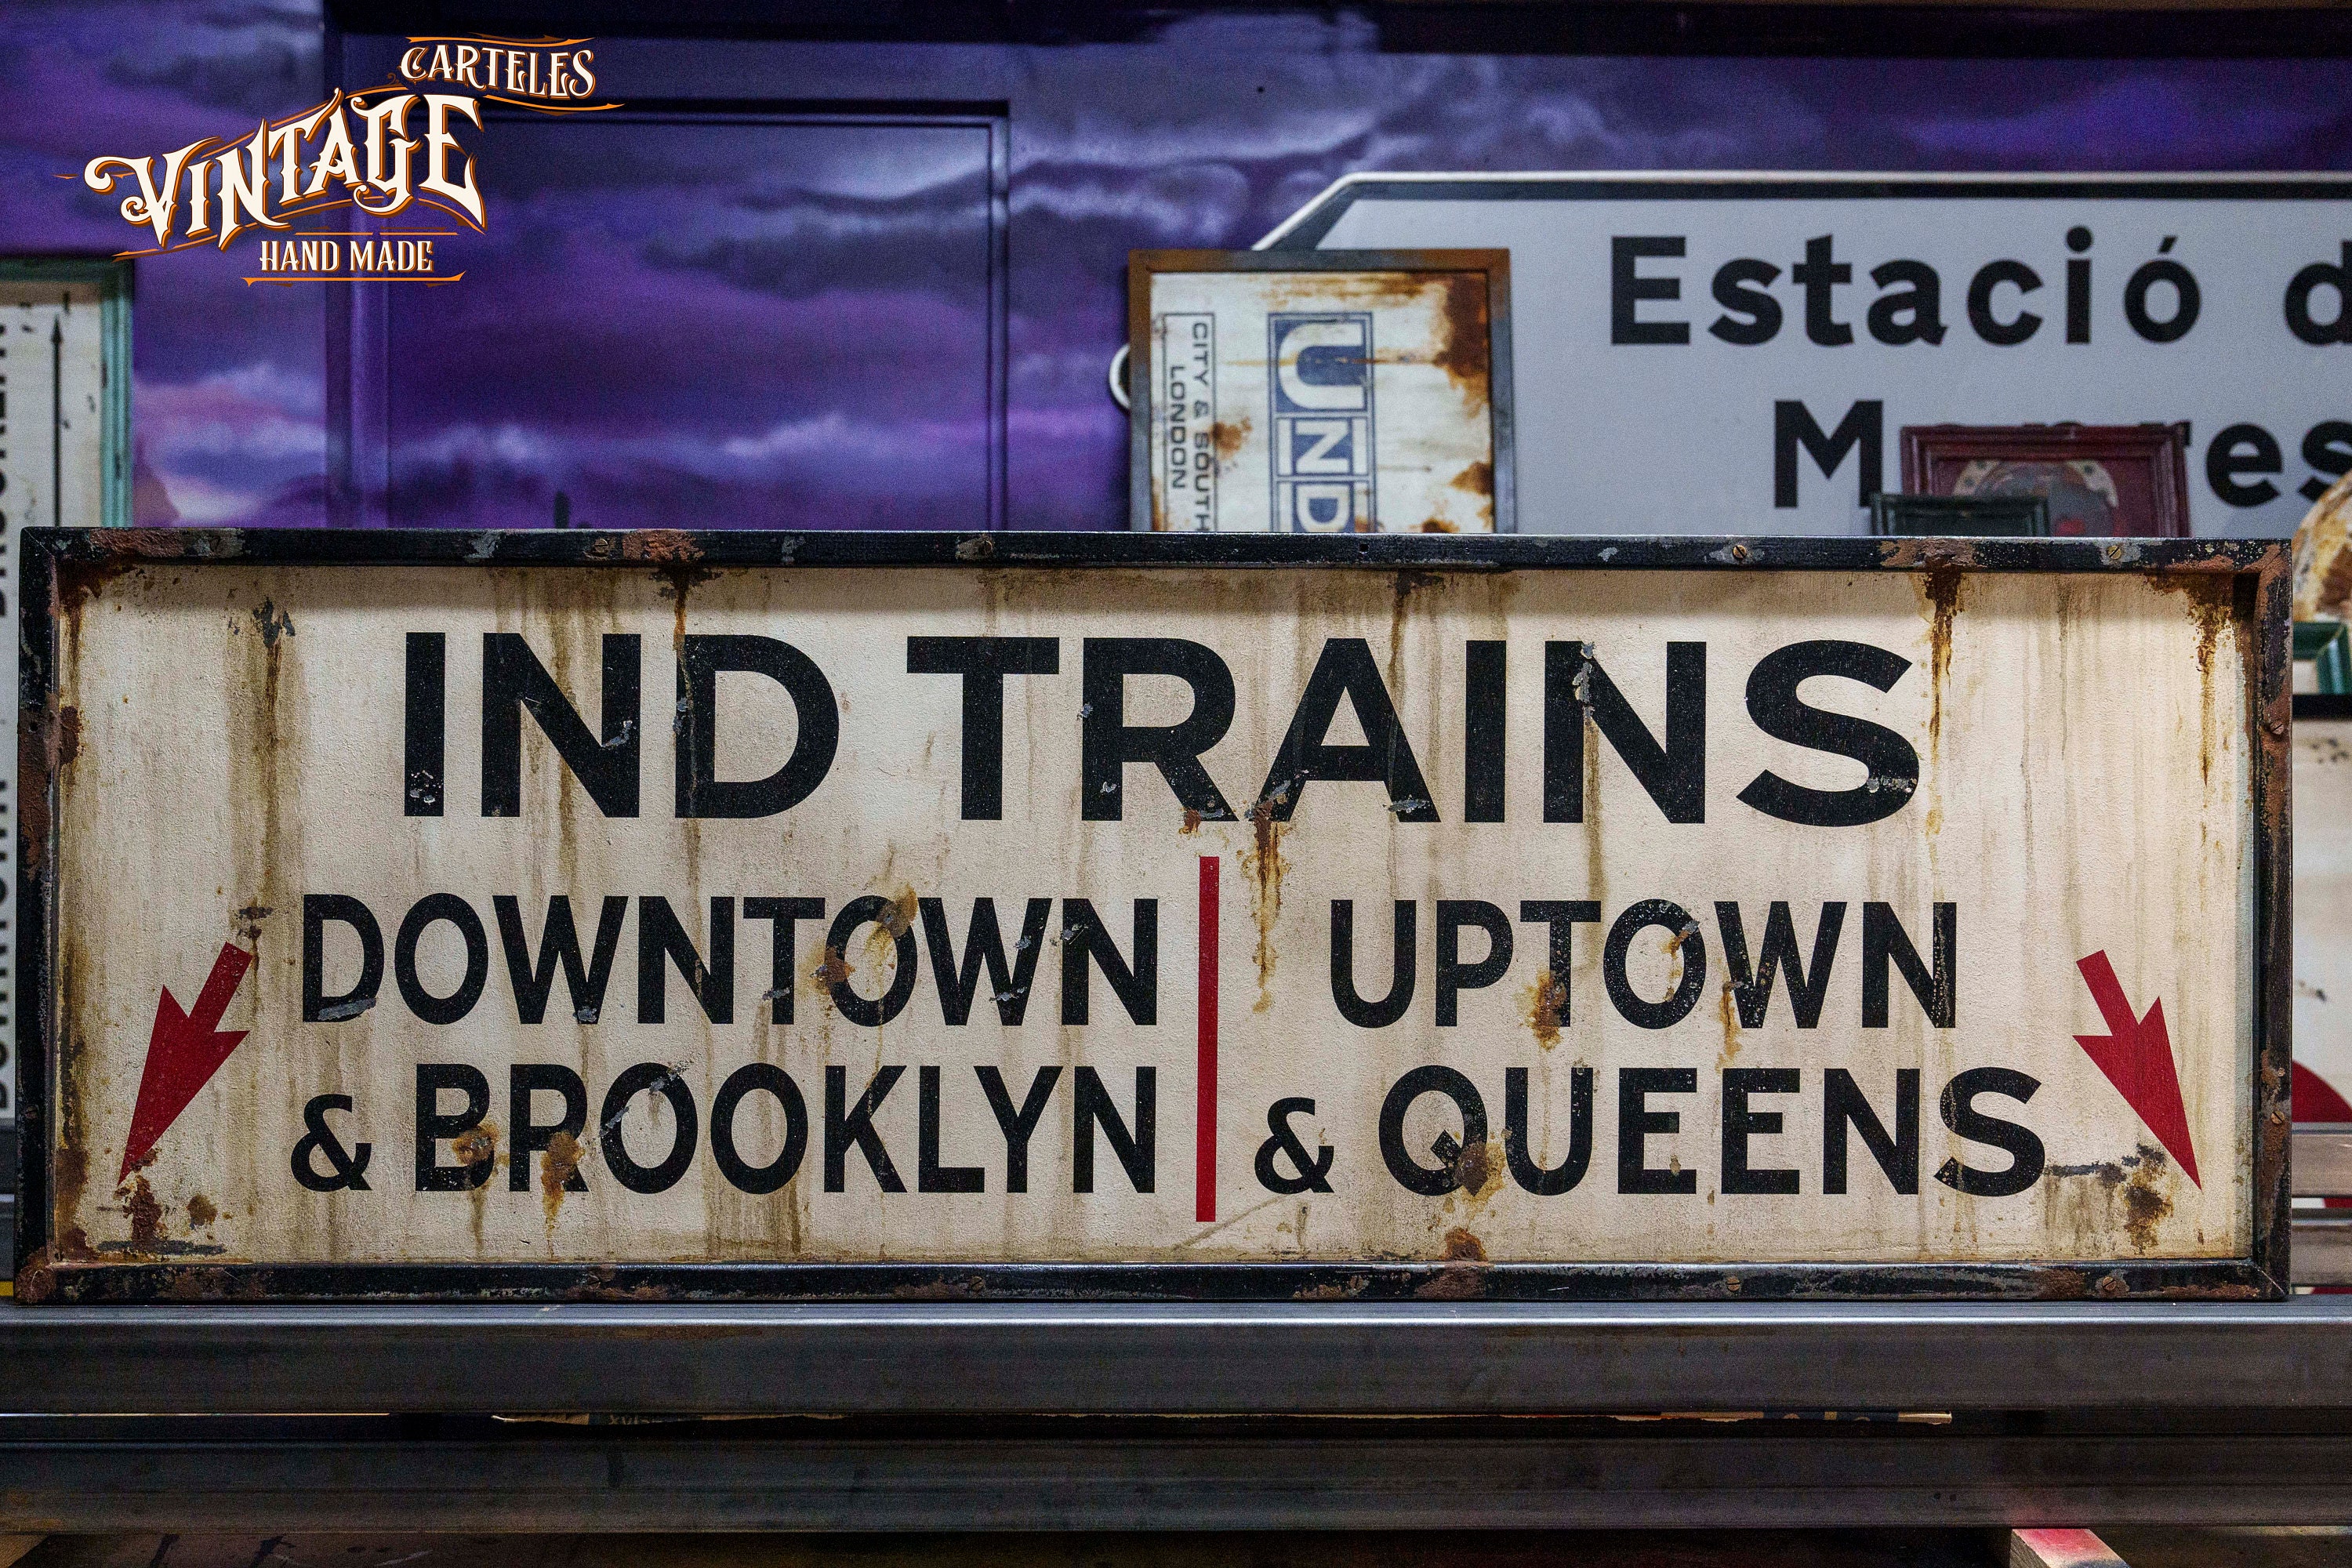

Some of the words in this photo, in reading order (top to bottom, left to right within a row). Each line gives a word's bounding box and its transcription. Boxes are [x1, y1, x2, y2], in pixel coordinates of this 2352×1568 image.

[1610, 225, 2201, 347] Estació
[1192, 321, 1210, 387] CITY
[1170, 365, 1186, 489] LONDON
[1193, 432, 1210, 532] SOUTH
[404, 632, 840, 818] IND
[906, 636, 1921, 827] TRAINS
[301, 892, 1159, 1027] DOWNTOWN
[1330, 898, 1958, 1030] UPTOWN
[290, 1093, 372, 1192] &
[415, 1062, 1157, 1195] BROOKLYN
[1254, 1096, 1335, 1195] &
[1377, 1064, 2045, 1197] QUEENS
